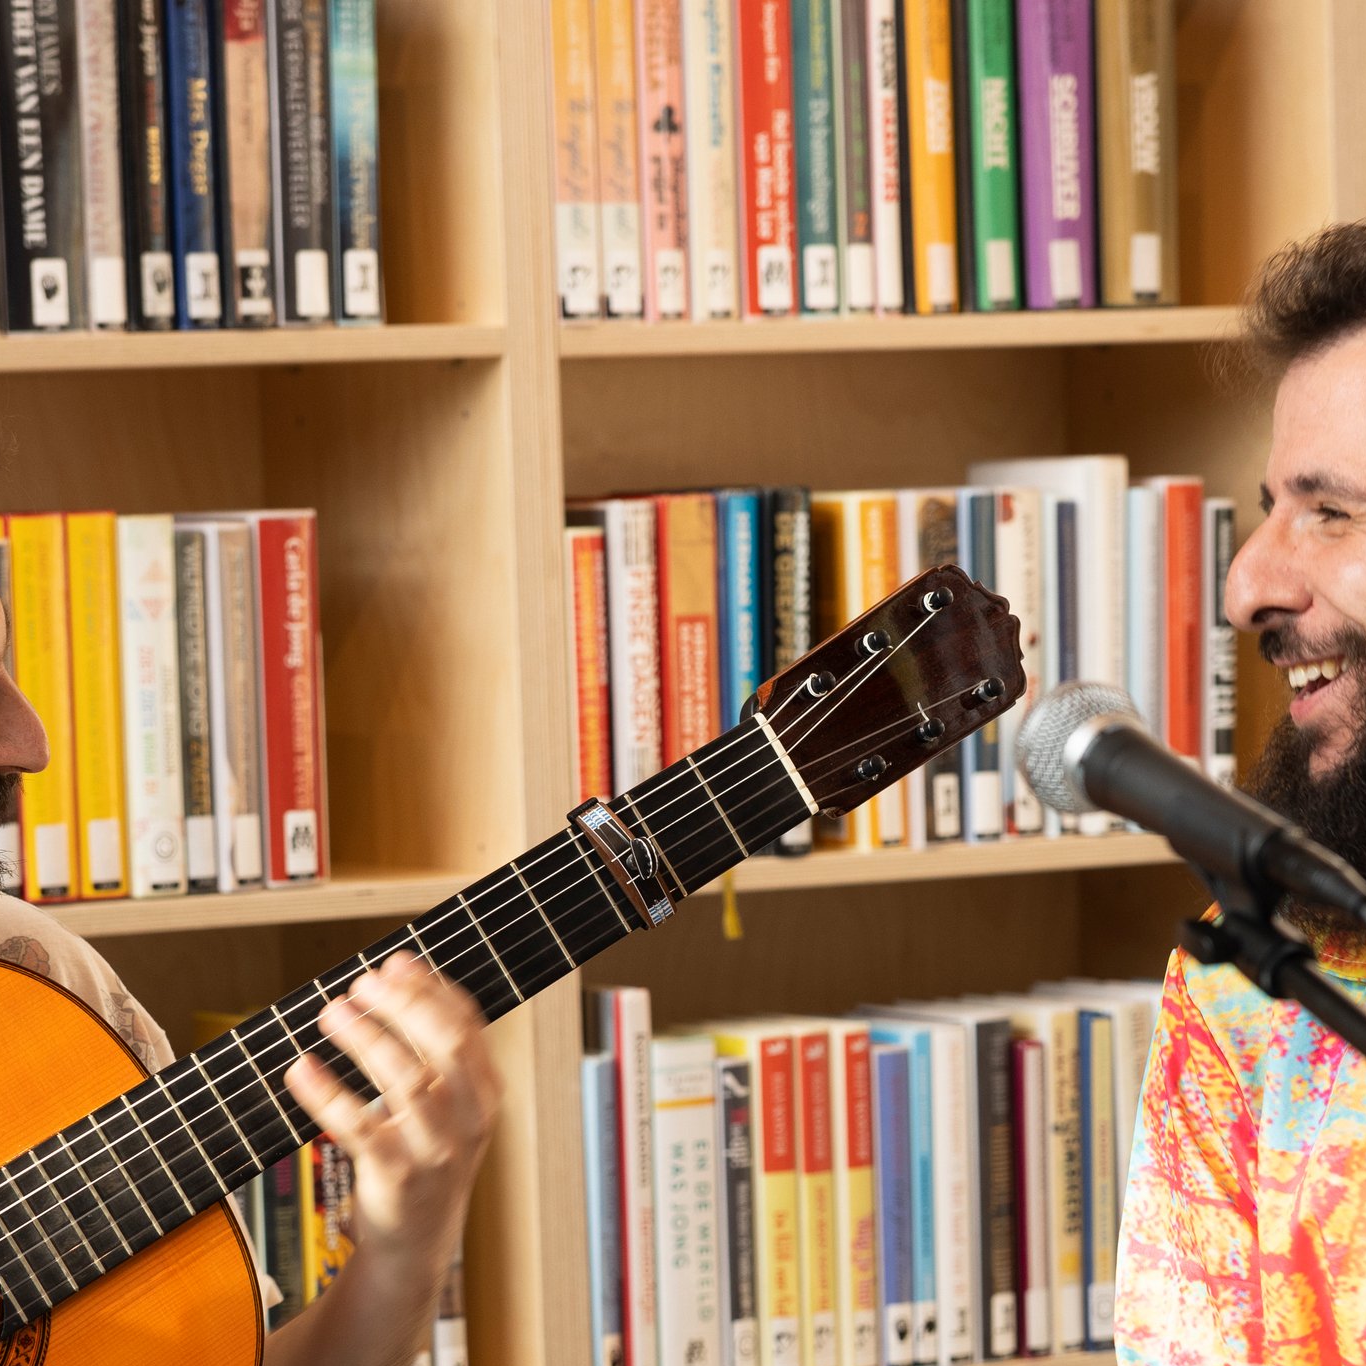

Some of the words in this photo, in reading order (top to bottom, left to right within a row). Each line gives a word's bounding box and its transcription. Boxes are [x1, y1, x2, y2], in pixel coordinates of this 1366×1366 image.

[14, 65, 38, 113] VAN
[20, 175, 47, 248] DAME
[283, 536, 306, 591] Carla
[287, 598, 306, 619] de
[775, 564, 797, 678] GREPPE
[283, 623, 307, 670] Jong
[186, 667, 206, 737] JONG
[670, 1142, 685, 1192] WAS
[695, 1140, 710, 1171] EN
[696, 1182, 711, 1212] DE
[669, 1203, 688, 1269] JONG
[698, 1222, 714, 1322] WERELD
